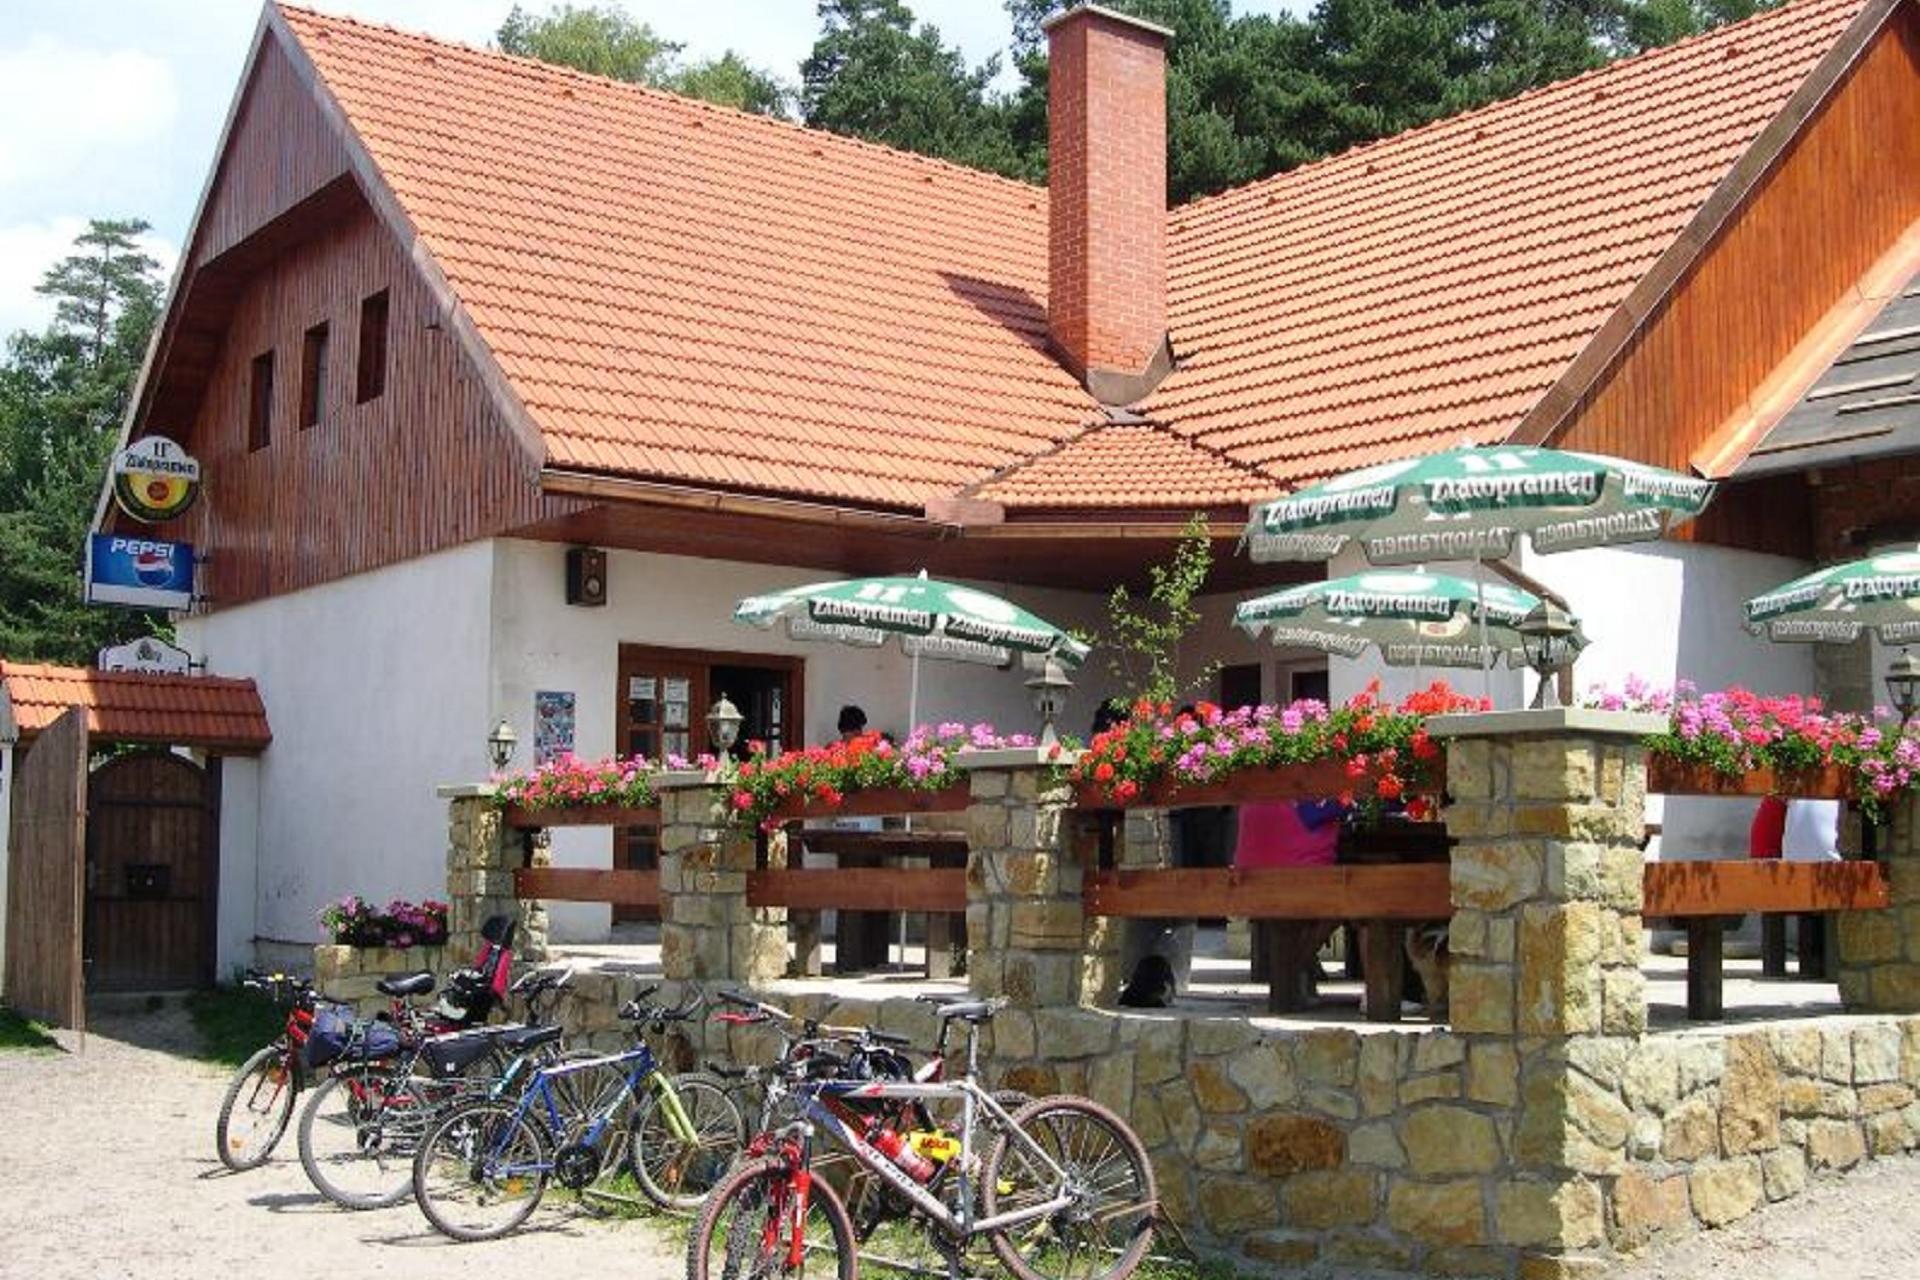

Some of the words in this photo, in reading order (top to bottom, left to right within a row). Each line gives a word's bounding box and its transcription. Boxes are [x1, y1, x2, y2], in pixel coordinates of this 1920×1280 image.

[1424, 471, 1596, 502] Zlatopramen
[1265, 485, 1395, 526] Zlatopramen
[110, 538, 175, 557] PEPSI
[1325, 590, 1451, 615] Zlatopramen
